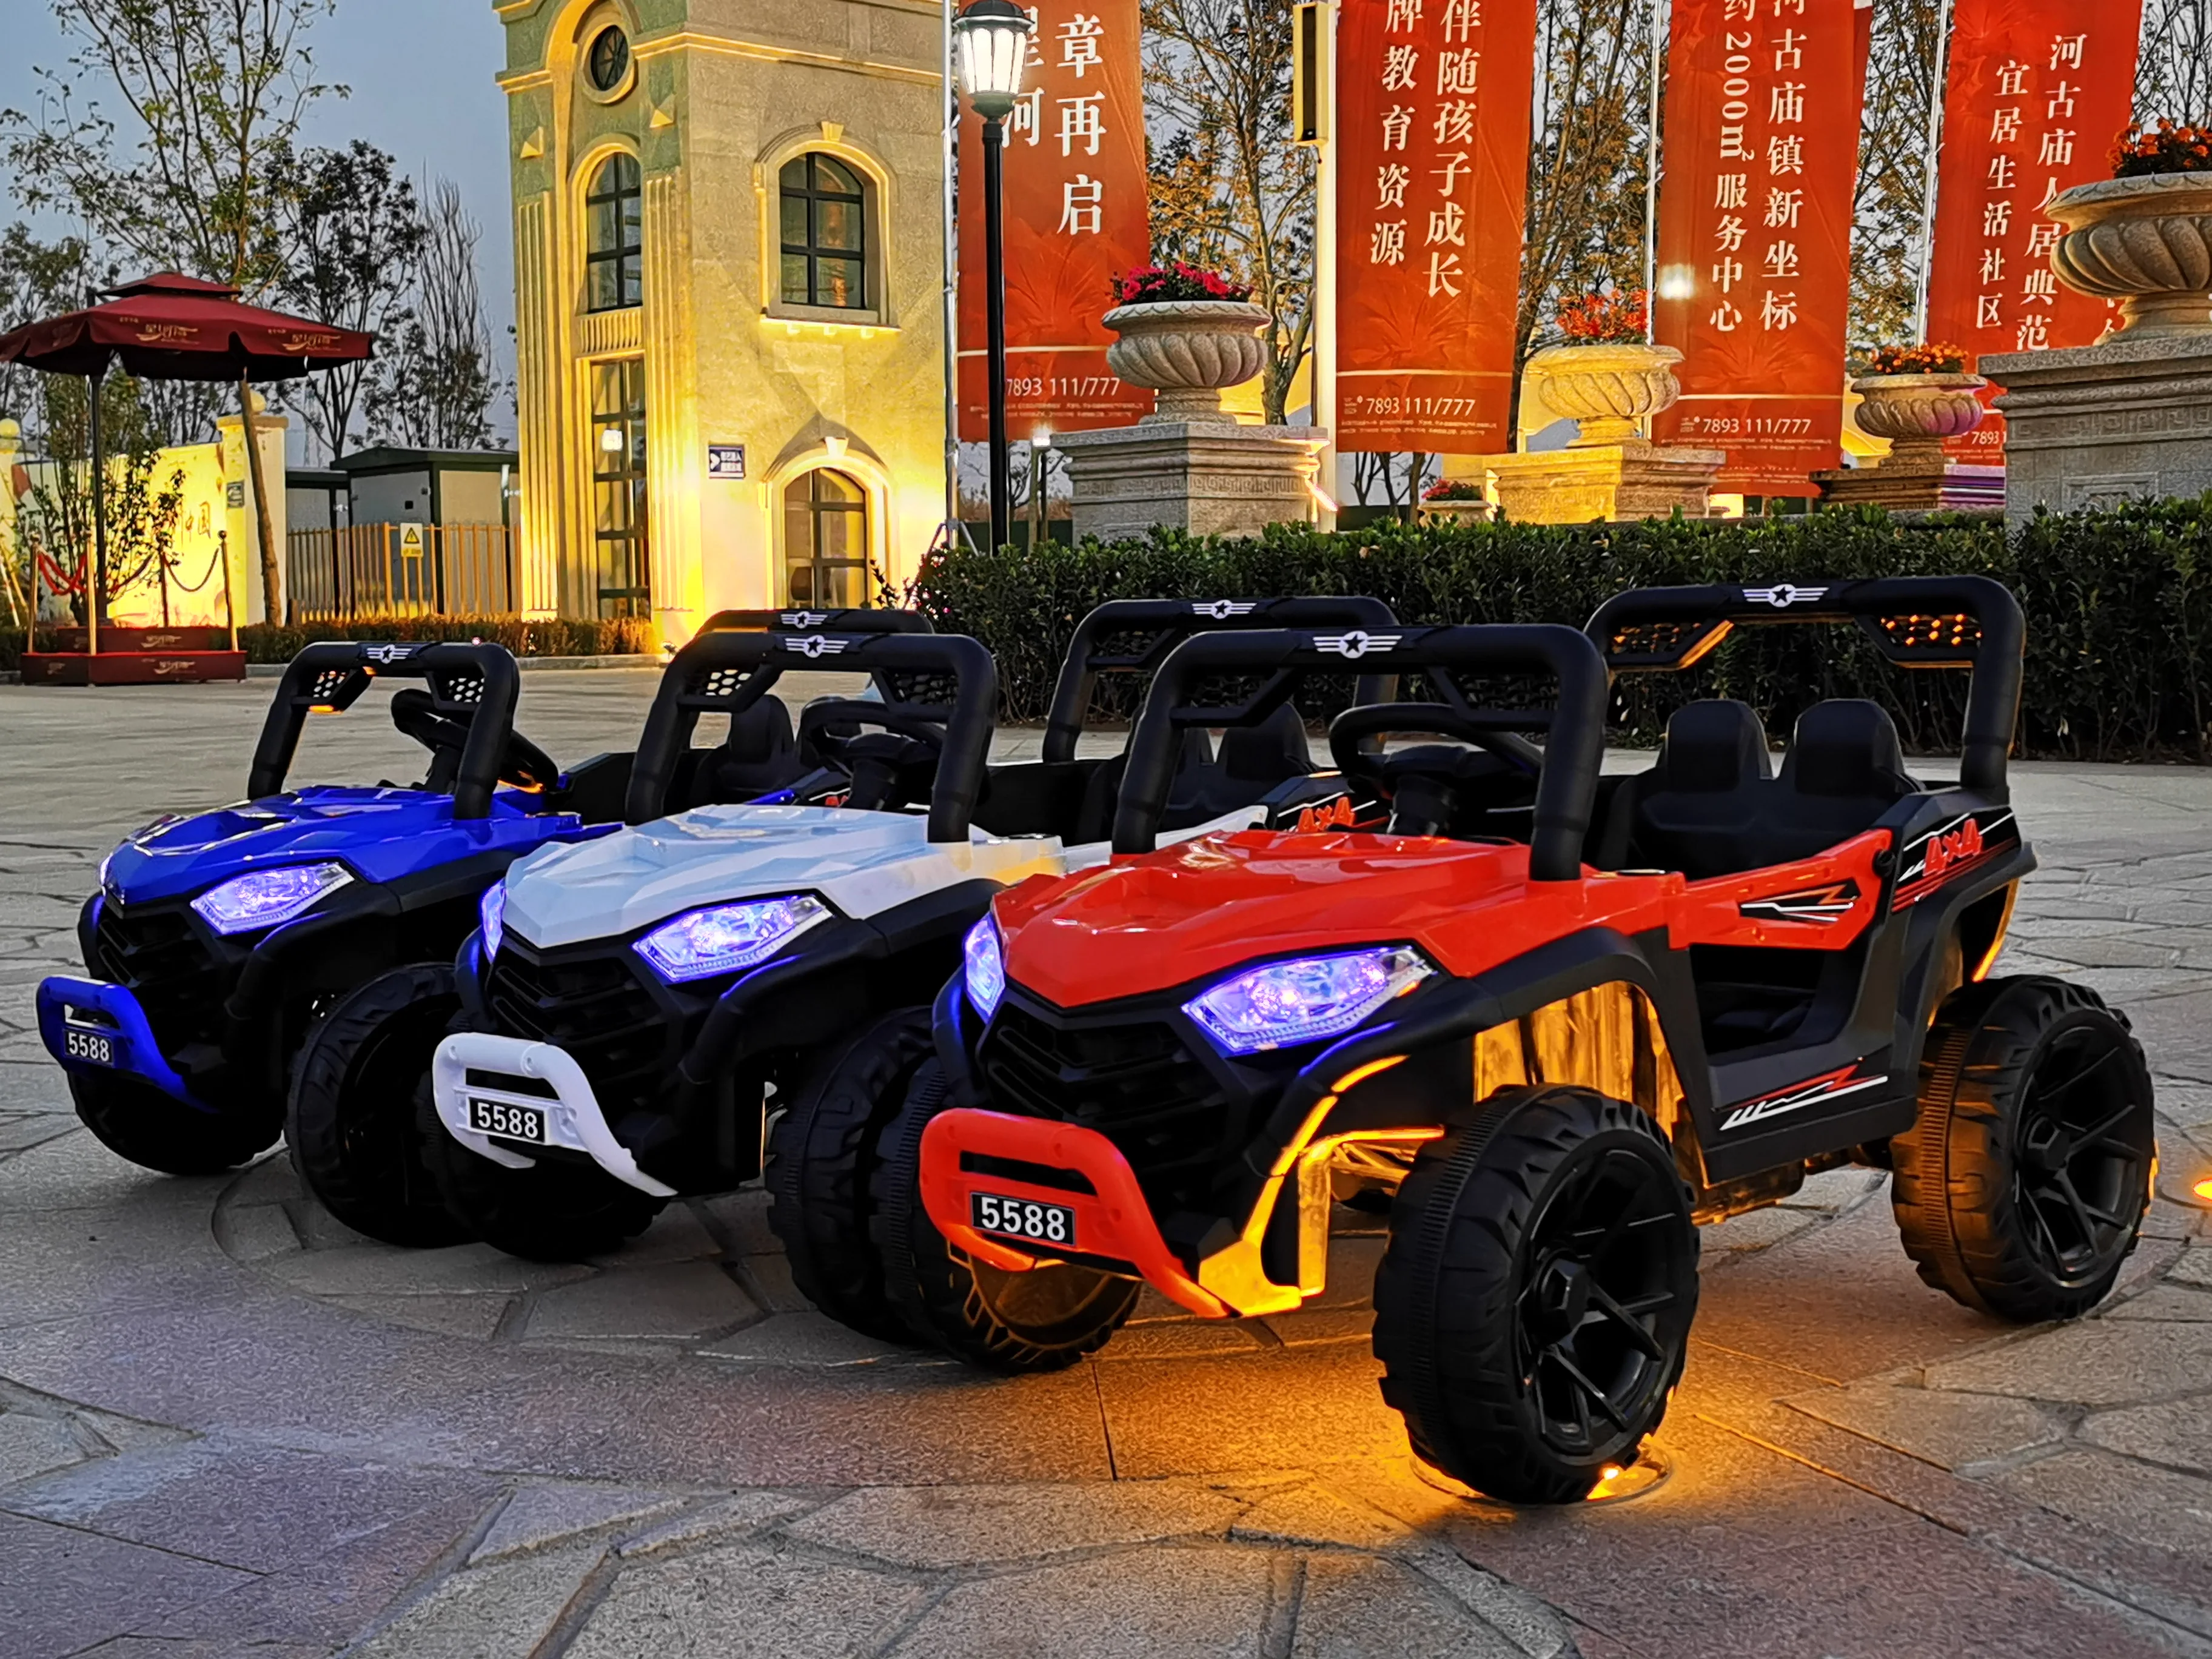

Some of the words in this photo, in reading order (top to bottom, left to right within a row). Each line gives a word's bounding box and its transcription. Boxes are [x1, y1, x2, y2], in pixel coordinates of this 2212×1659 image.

[1055, 13, 1107, 235] 章再启
[1370, 0, 1424, 267] 牌教育资源
[1423, 0, 1481, 298] 伴随孩子成长
[1976, 59, 2031, 329] 宜居生活社区
[1050, 376, 1120, 397] 111/777
[1366, 397, 1400, 415] 7893
[1405, 397, 1476, 417] 111/777
[1703, 418, 1740, 434] 7893
[1746, 418, 1811, 434] 111/777
[1971, 431, 2000, 444] 7893
[69, 1032, 110, 1062] 5588
[478, 1102, 538, 1139] 5588
[981, 1196, 1066, 1241] 5588
